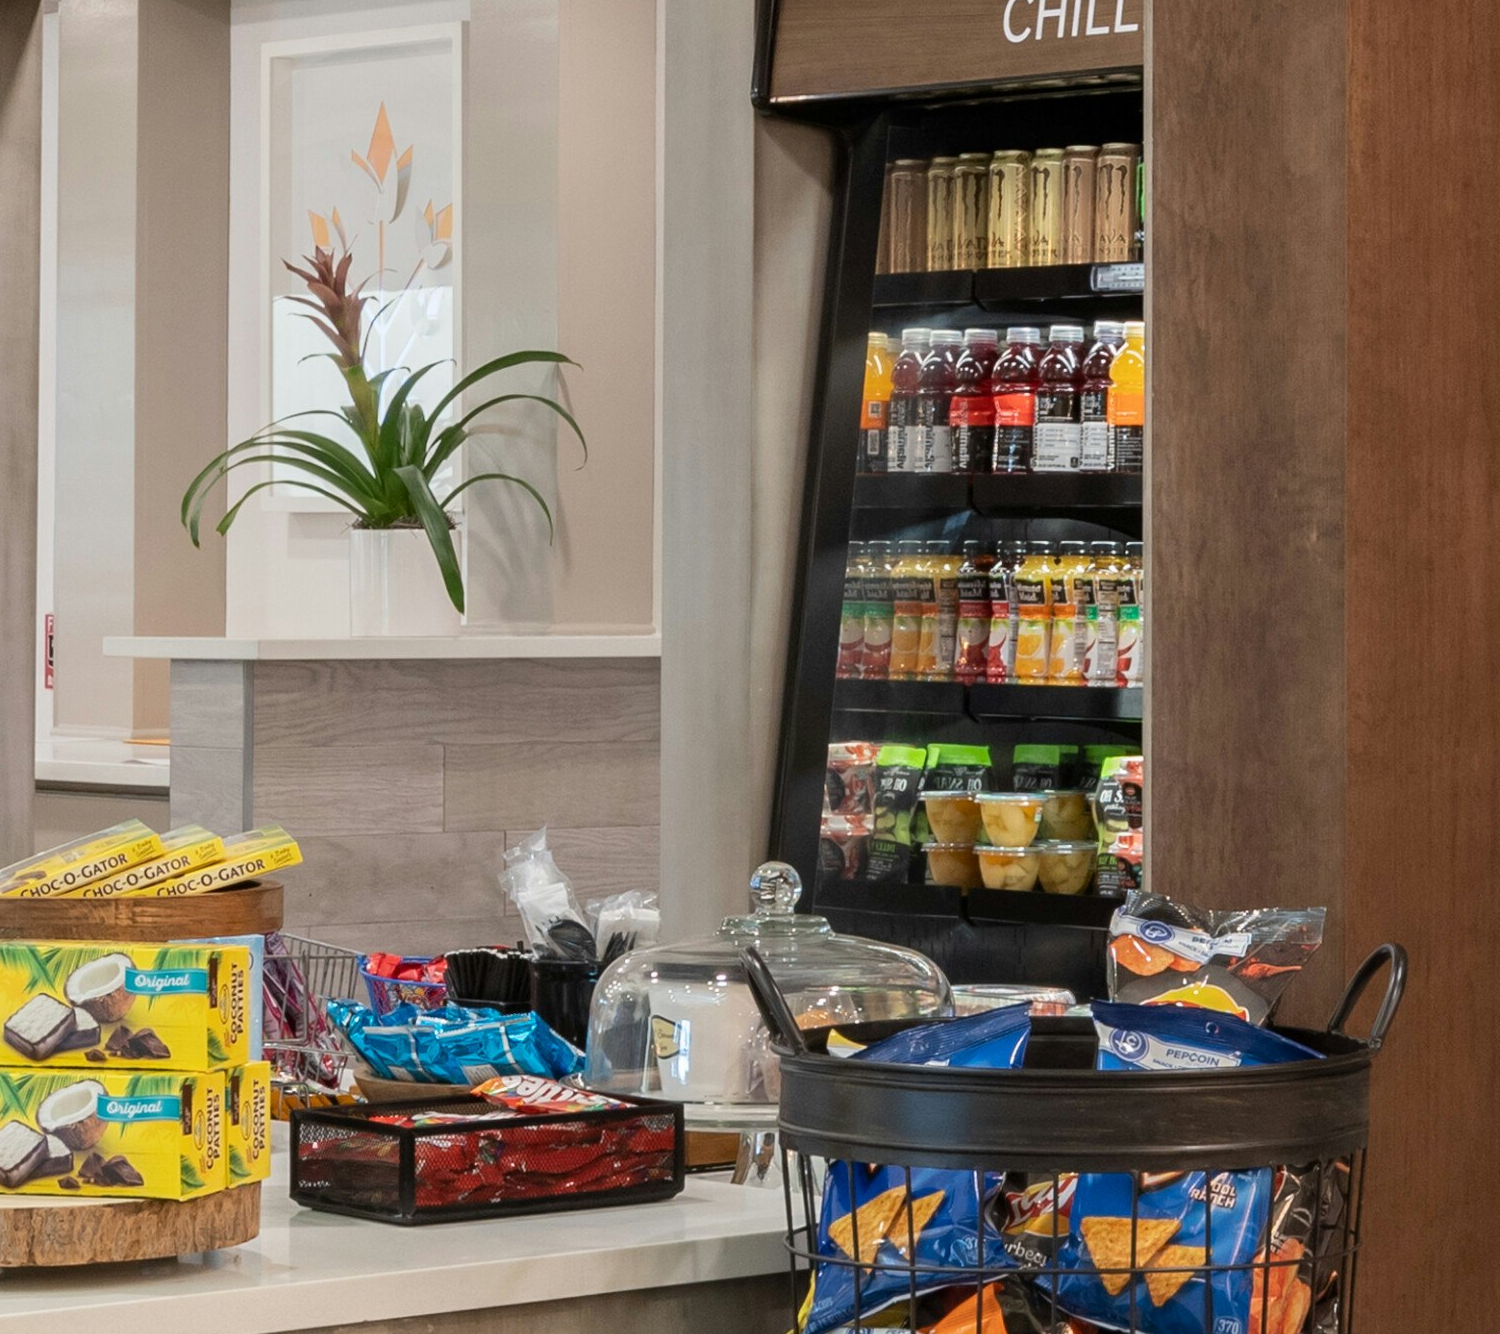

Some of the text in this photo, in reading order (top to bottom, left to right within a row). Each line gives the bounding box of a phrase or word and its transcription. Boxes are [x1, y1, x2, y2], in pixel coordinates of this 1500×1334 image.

[134, 973, 190, 991] Original
[1165, 1048, 1220, 1066] PEPCOIN
[105, 1099, 163, 1118] Original
